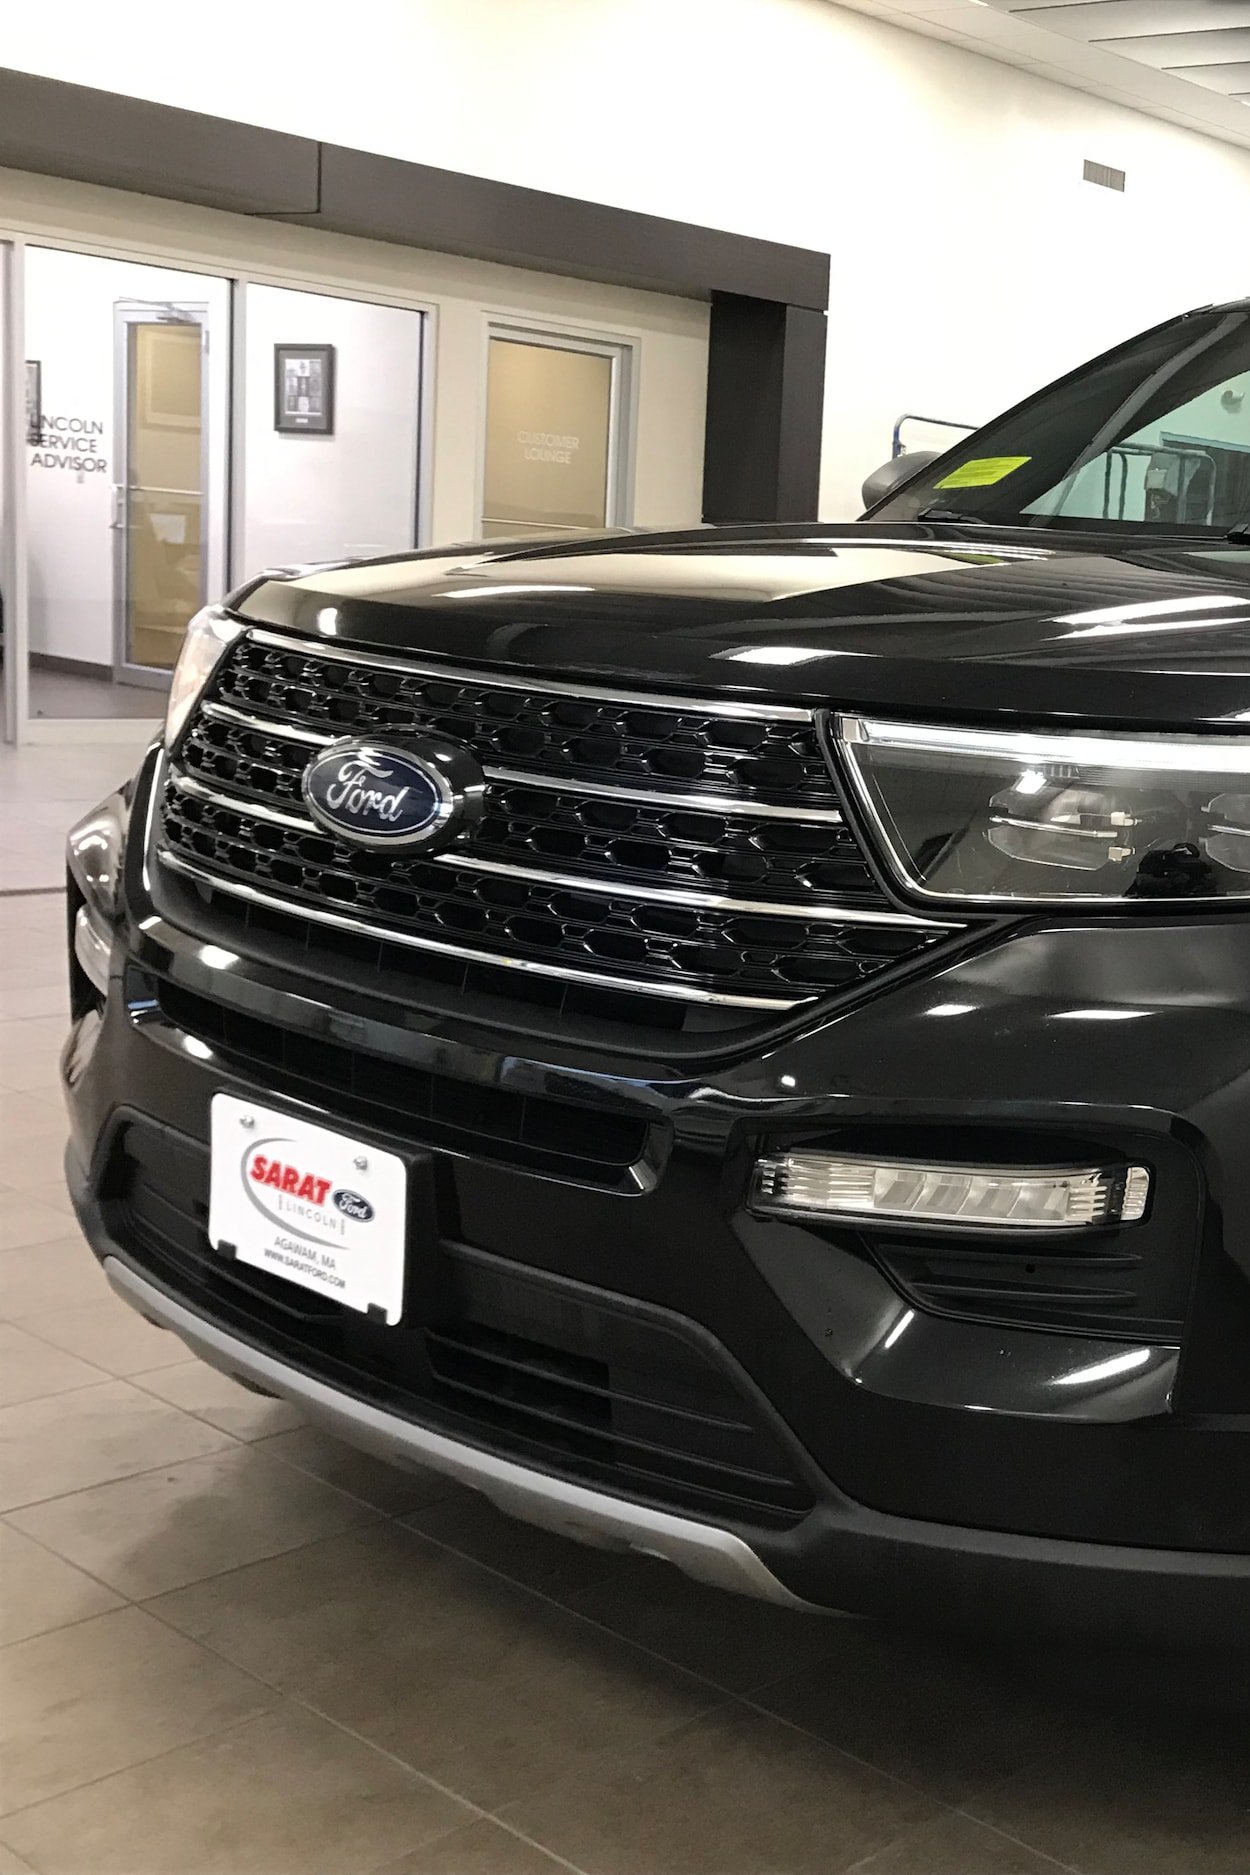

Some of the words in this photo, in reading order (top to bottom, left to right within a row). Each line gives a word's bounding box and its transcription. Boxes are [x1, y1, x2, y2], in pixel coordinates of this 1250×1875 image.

[30, 453, 107, 473] ADVISOR
[523, 447, 571, 465] LOUNGE
[325, 759, 411, 822] Ford
[250, 1154, 333, 1206] SARAT
[286, 1200, 338, 1229] LINCOLN
[338, 1192, 369, 1219] Ford
[274, 1236, 320, 1265] AGAWAM,
[321, 1254, 337, 1269] MA
[264, 1248, 347, 1289] WWW.SARATFORD.COM
